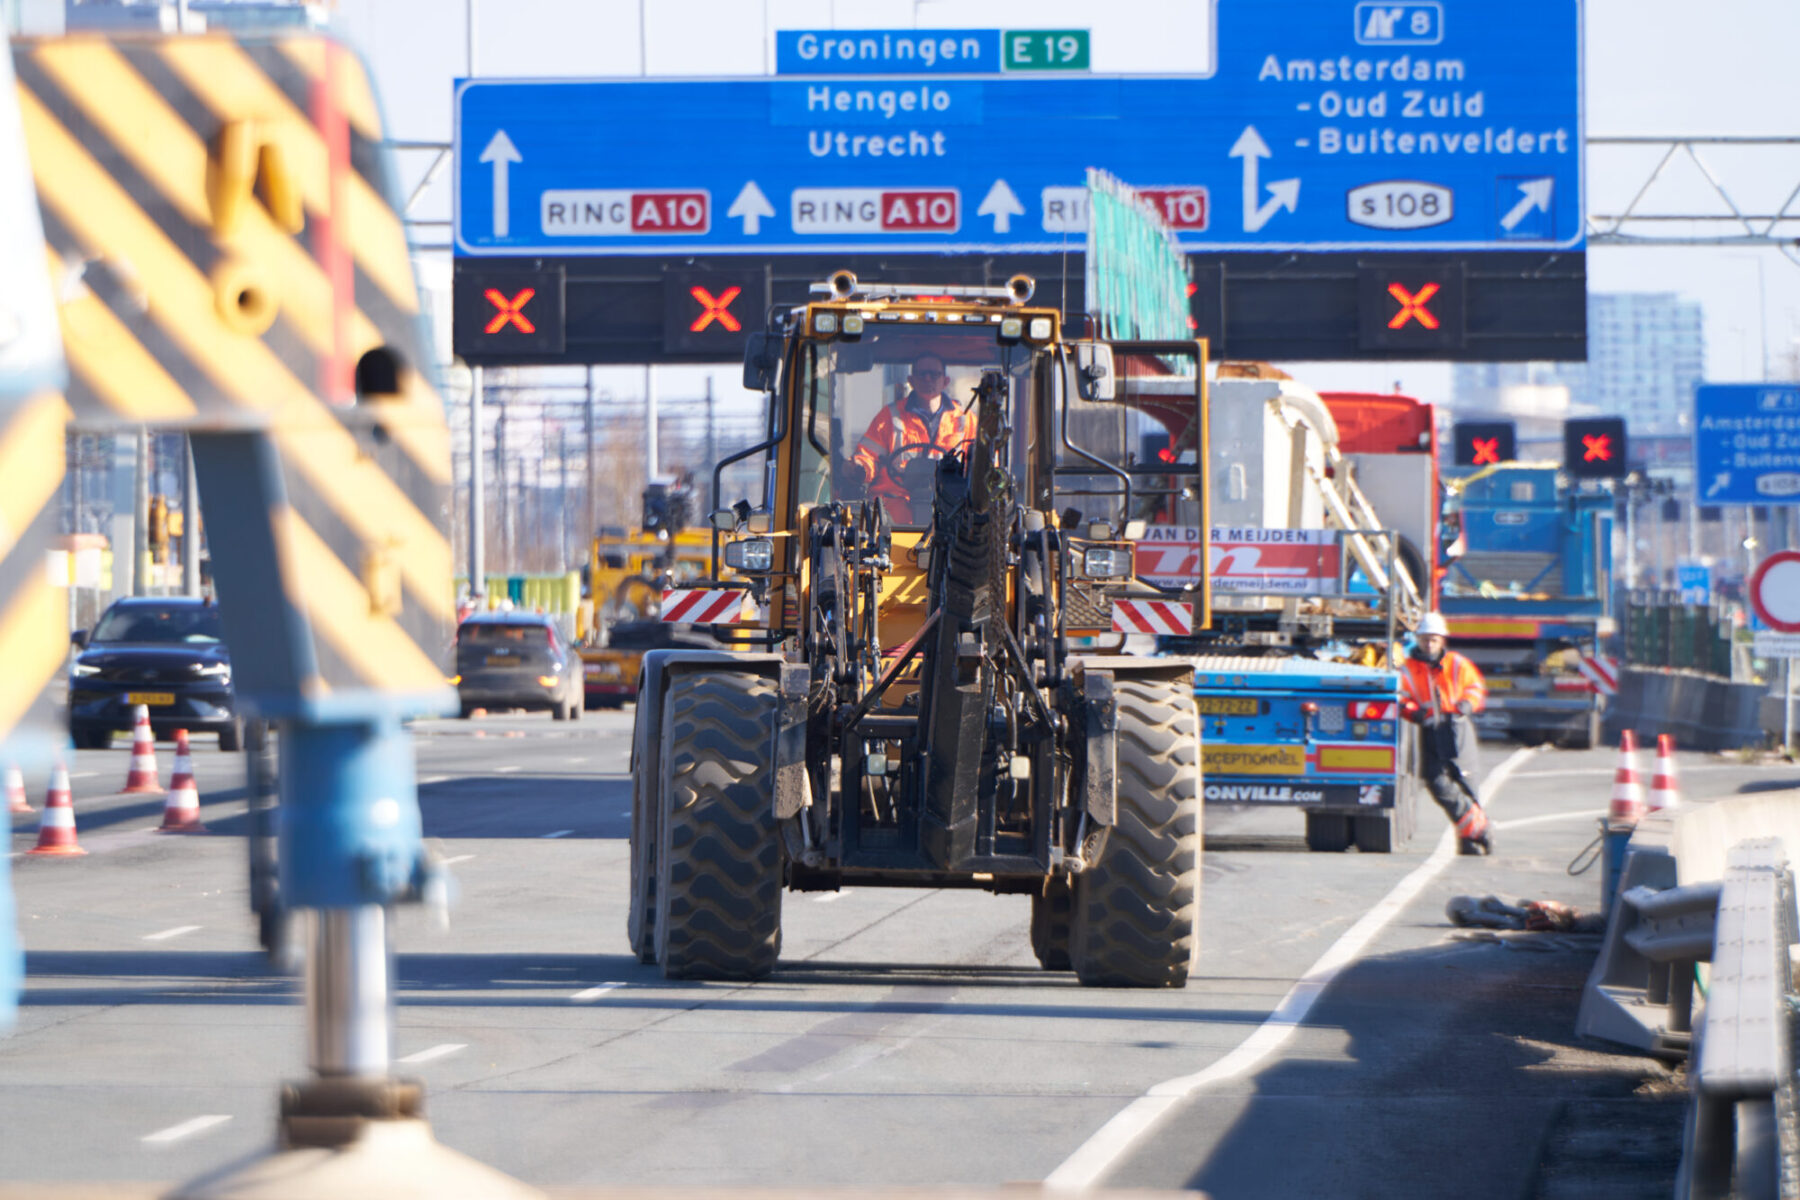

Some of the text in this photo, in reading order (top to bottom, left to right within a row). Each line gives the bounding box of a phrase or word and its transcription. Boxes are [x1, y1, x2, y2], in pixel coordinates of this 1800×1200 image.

[1410, 8, 1430, 35] 8
[797, 34, 980, 67] Groningen
[1013, 36, 1079, 63] E 19
[1258, 55, 1465, 82] Amsterdam
[807, 87, 951, 119] Hengelo
[1401, 91, 1484, 117] Zuid
[808, 131, 946, 157] Utrecht
[1318, 127, 1569, 154] Buitenveldert
[548, 199, 703, 227] RING A10
[798, 198, 953, 224] RING A10
[1049, 200, 1091, 220] RI
[1701, 416, 1800, 430] Amsterda
[1144, 528, 1309, 543] VAN DR MEIJDEN
[1202, 752, 1299, 766] XCEPTIONNEL
